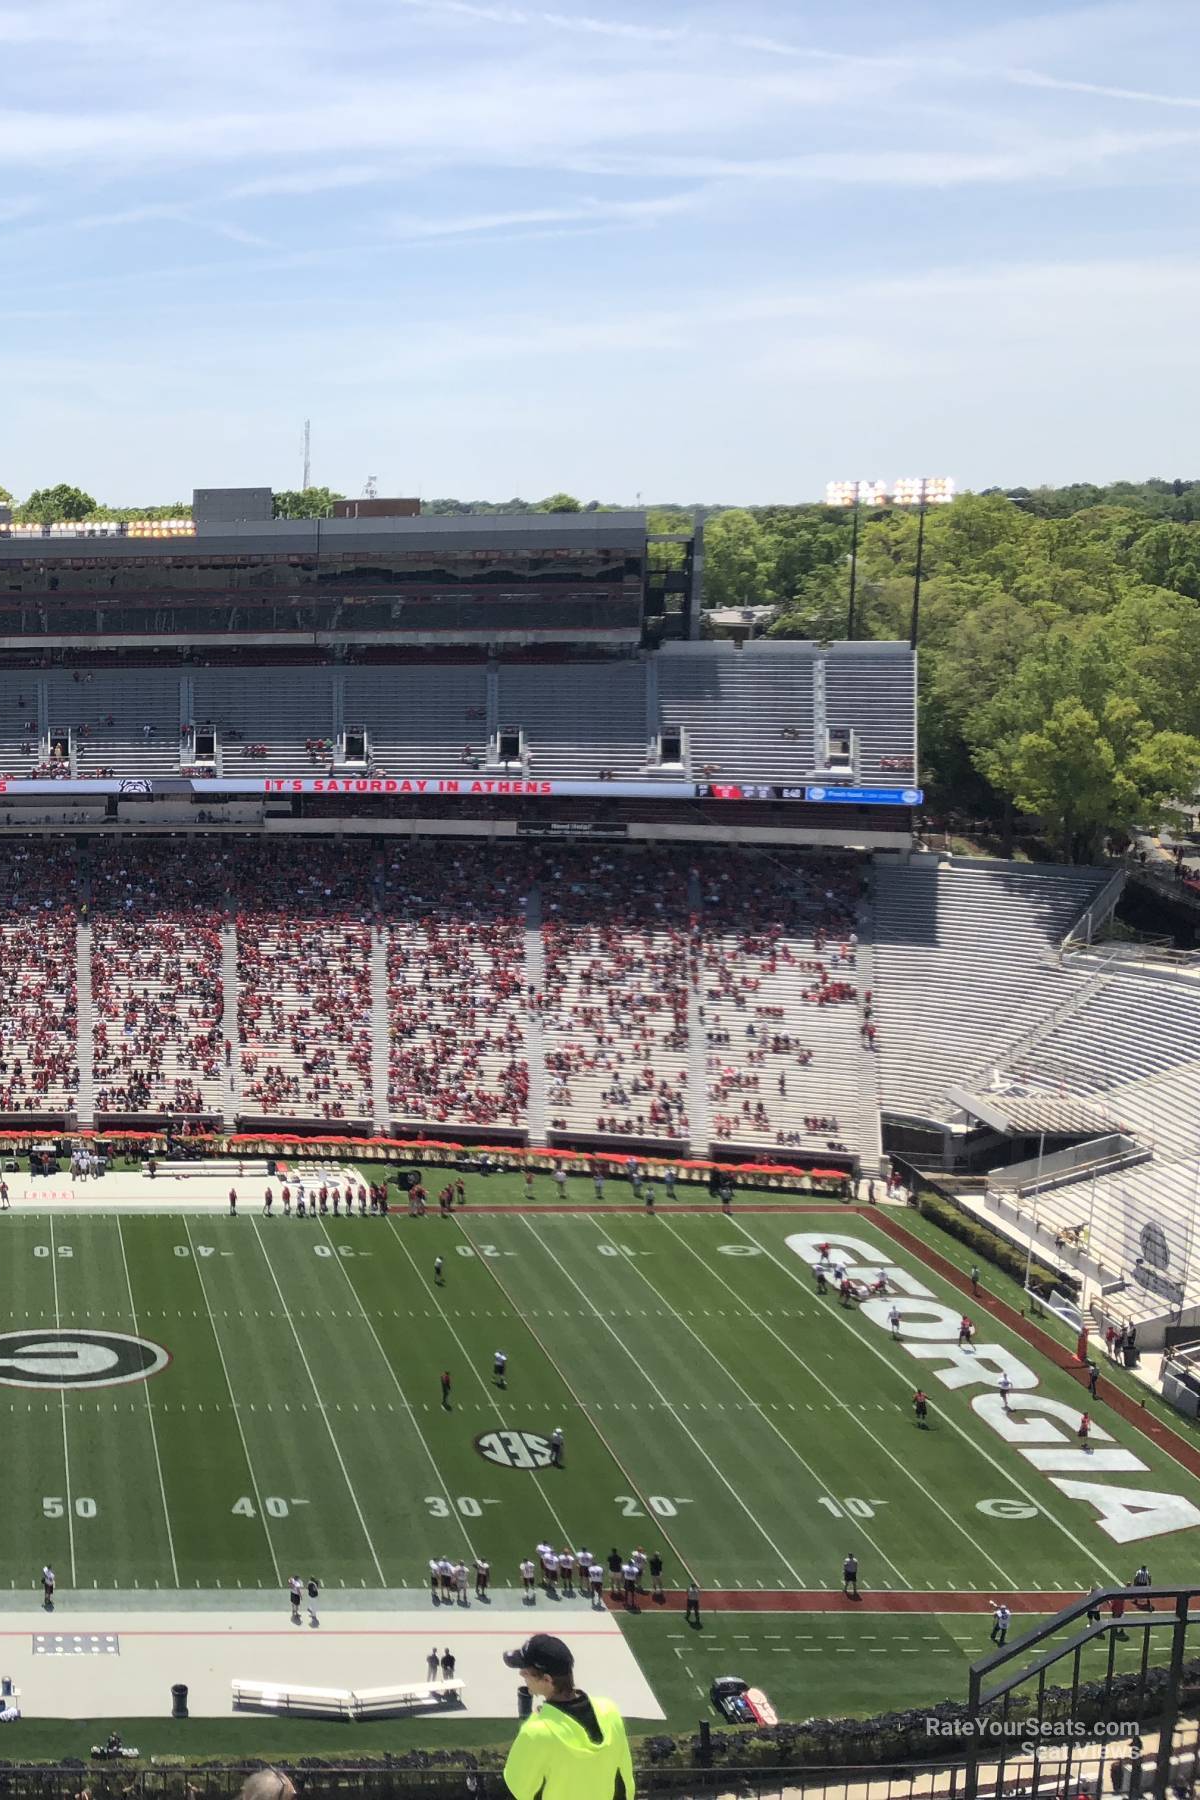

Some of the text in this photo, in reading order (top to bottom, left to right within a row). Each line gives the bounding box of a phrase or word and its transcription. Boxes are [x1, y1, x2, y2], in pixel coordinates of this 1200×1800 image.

[264, 779, 552, 793] IT'S SATURDAY IN ATHENS
[33, 1246, 74, 1258] 50
[173, 1245, 215, 1258] 40
[313, 1245, 356, 1258] 30
[455, 1245, 501, 1258] 20
[784, 1233, 1200, 1544] GEORGIA
[479, 1431, 553, 1468] SEC
[43, 1497, 97, 1518] 50
[231, 1496, 290, 1518] 40
[424, 1496, 483, 1518] 30
[614, 1496, 678, 1518] 20
[817, 1497, 876, 1518] 10
[975, 1499, 1039, 1519] G
